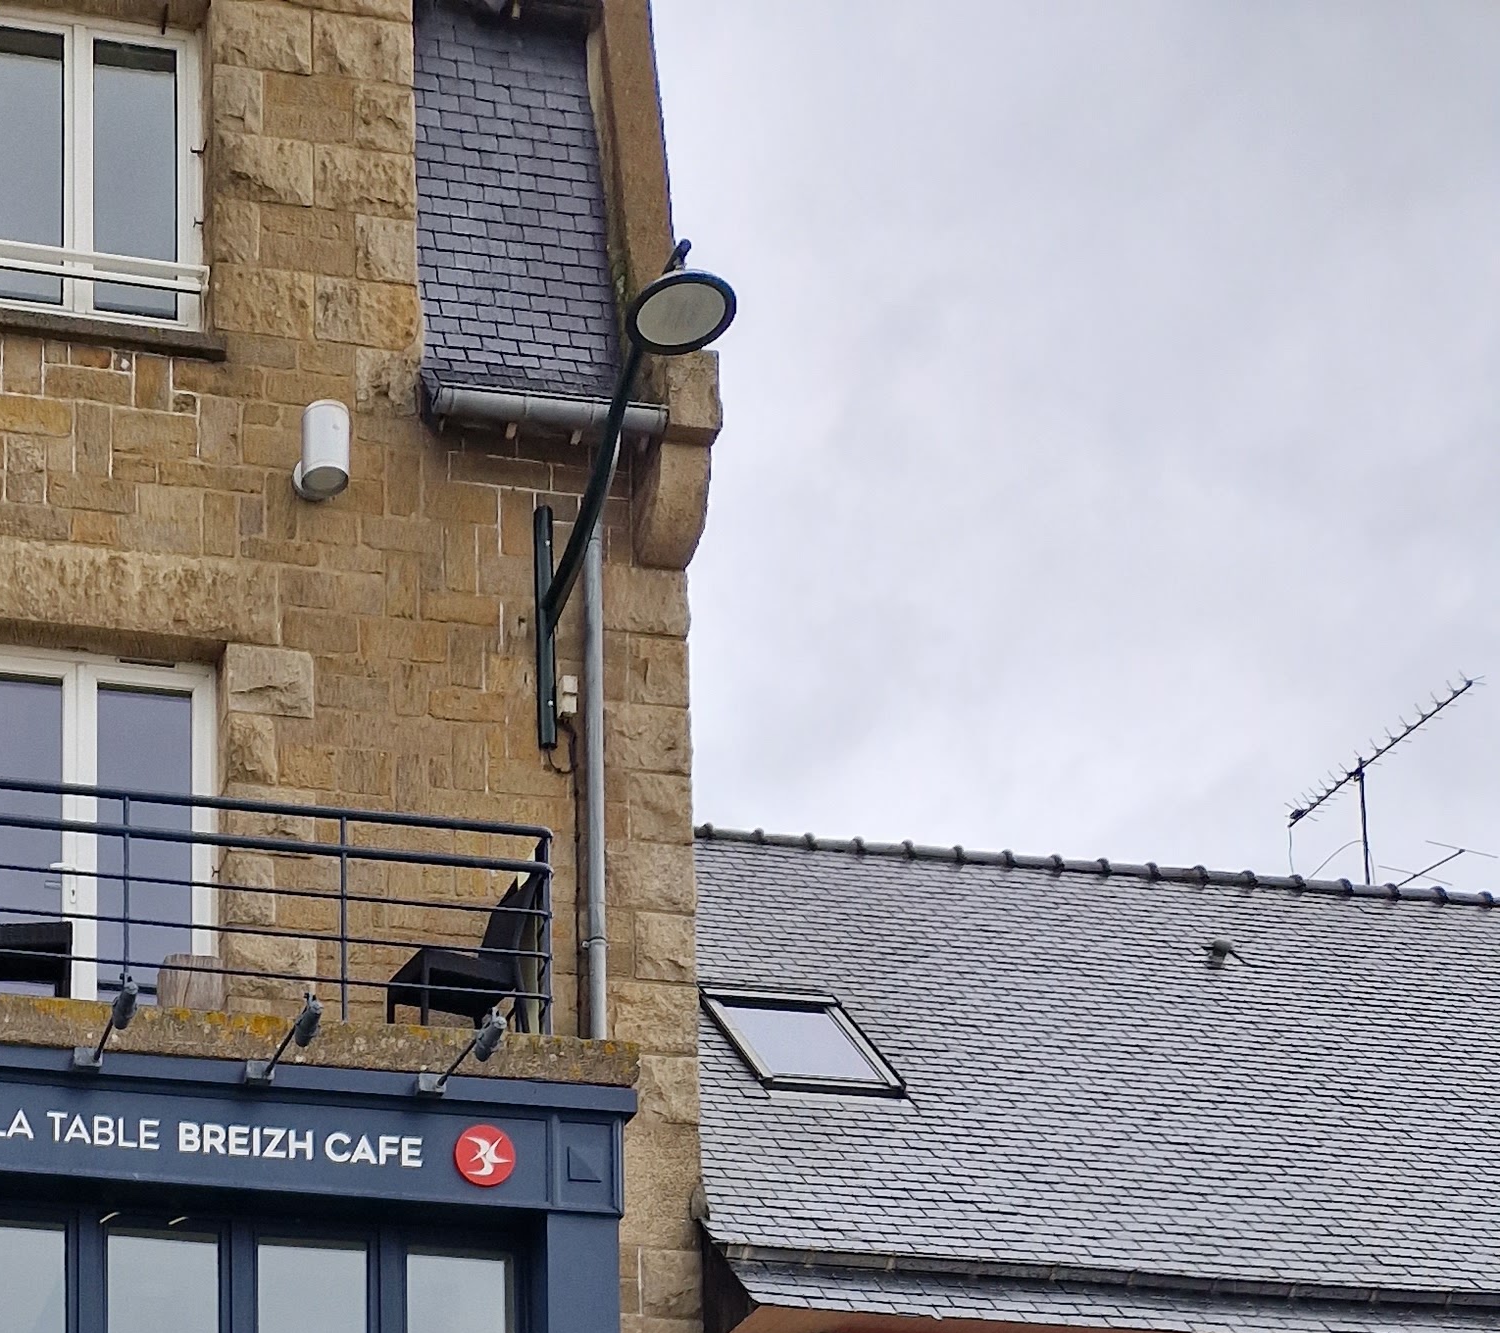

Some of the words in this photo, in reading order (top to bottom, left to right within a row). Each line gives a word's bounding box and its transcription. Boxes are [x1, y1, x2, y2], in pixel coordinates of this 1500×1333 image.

[46, 1111, 160, 1151] TABLE
[178, 1121, 315, 1162] BREIZH
[324, 1131, 423, 1168] CAFE
